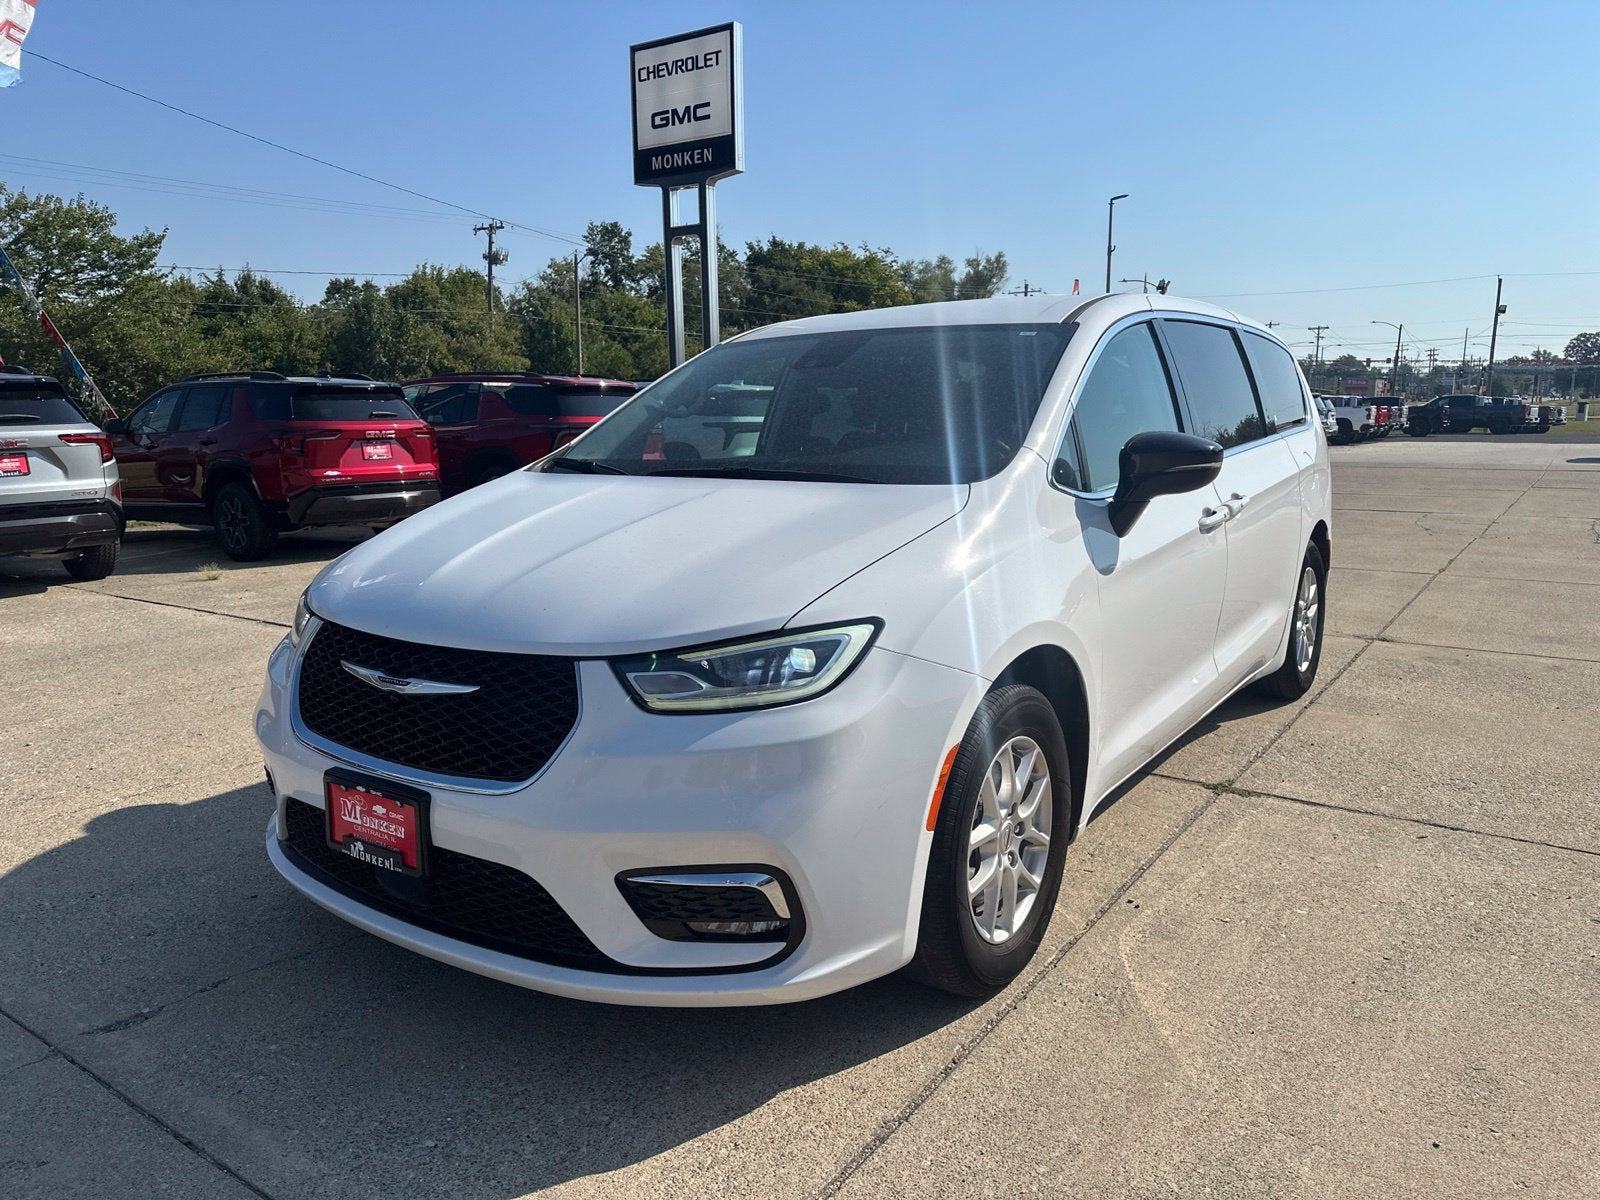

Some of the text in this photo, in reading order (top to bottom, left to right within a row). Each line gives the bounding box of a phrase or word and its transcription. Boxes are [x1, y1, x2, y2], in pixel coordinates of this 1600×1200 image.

[638, 50, 722, 82] CHEVROLET
[651, 101, 711, 130] GMC
[652, 147, 713, 171] MONKEN
[366, 430, 395, 438] GMC
[340, 797, 405, 838] MONKEN
[388, 811, 404, 821] GMC
